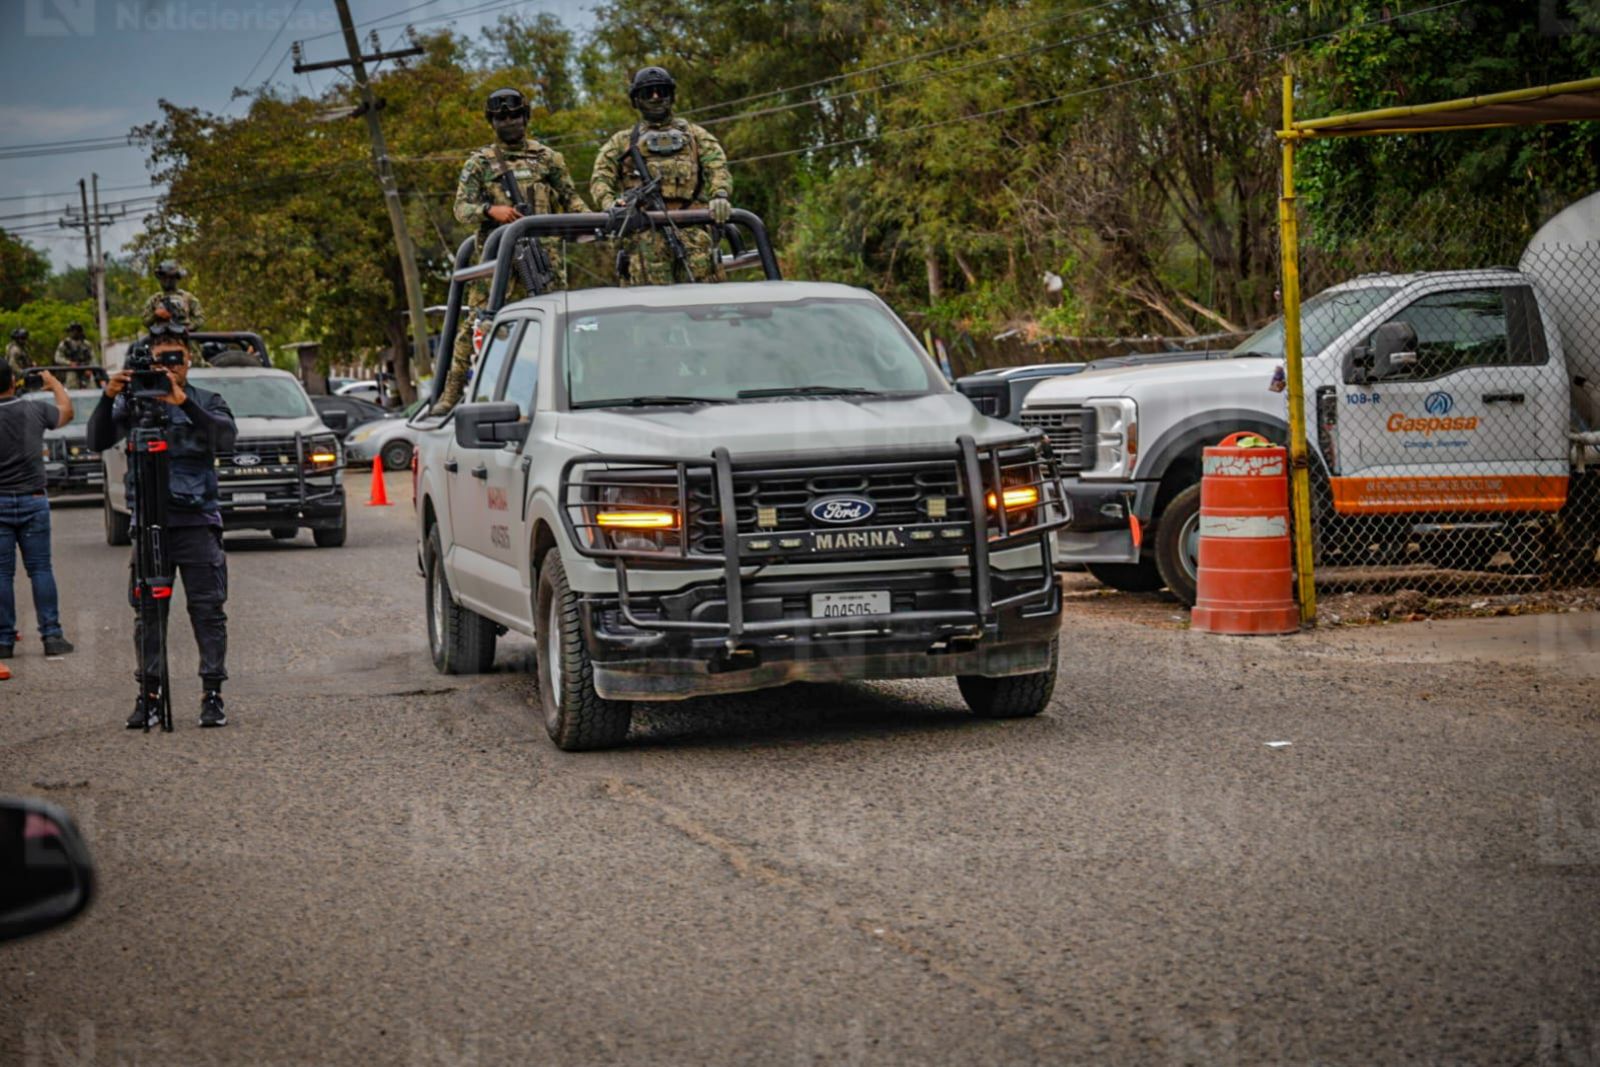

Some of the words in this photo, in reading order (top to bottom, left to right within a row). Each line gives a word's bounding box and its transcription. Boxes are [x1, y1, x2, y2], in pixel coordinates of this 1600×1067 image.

[1386, 412, 1478, 437] Gaspasa
[823, 502, 862, 519] Ford
[816, 531, 898, 549] MARINA
